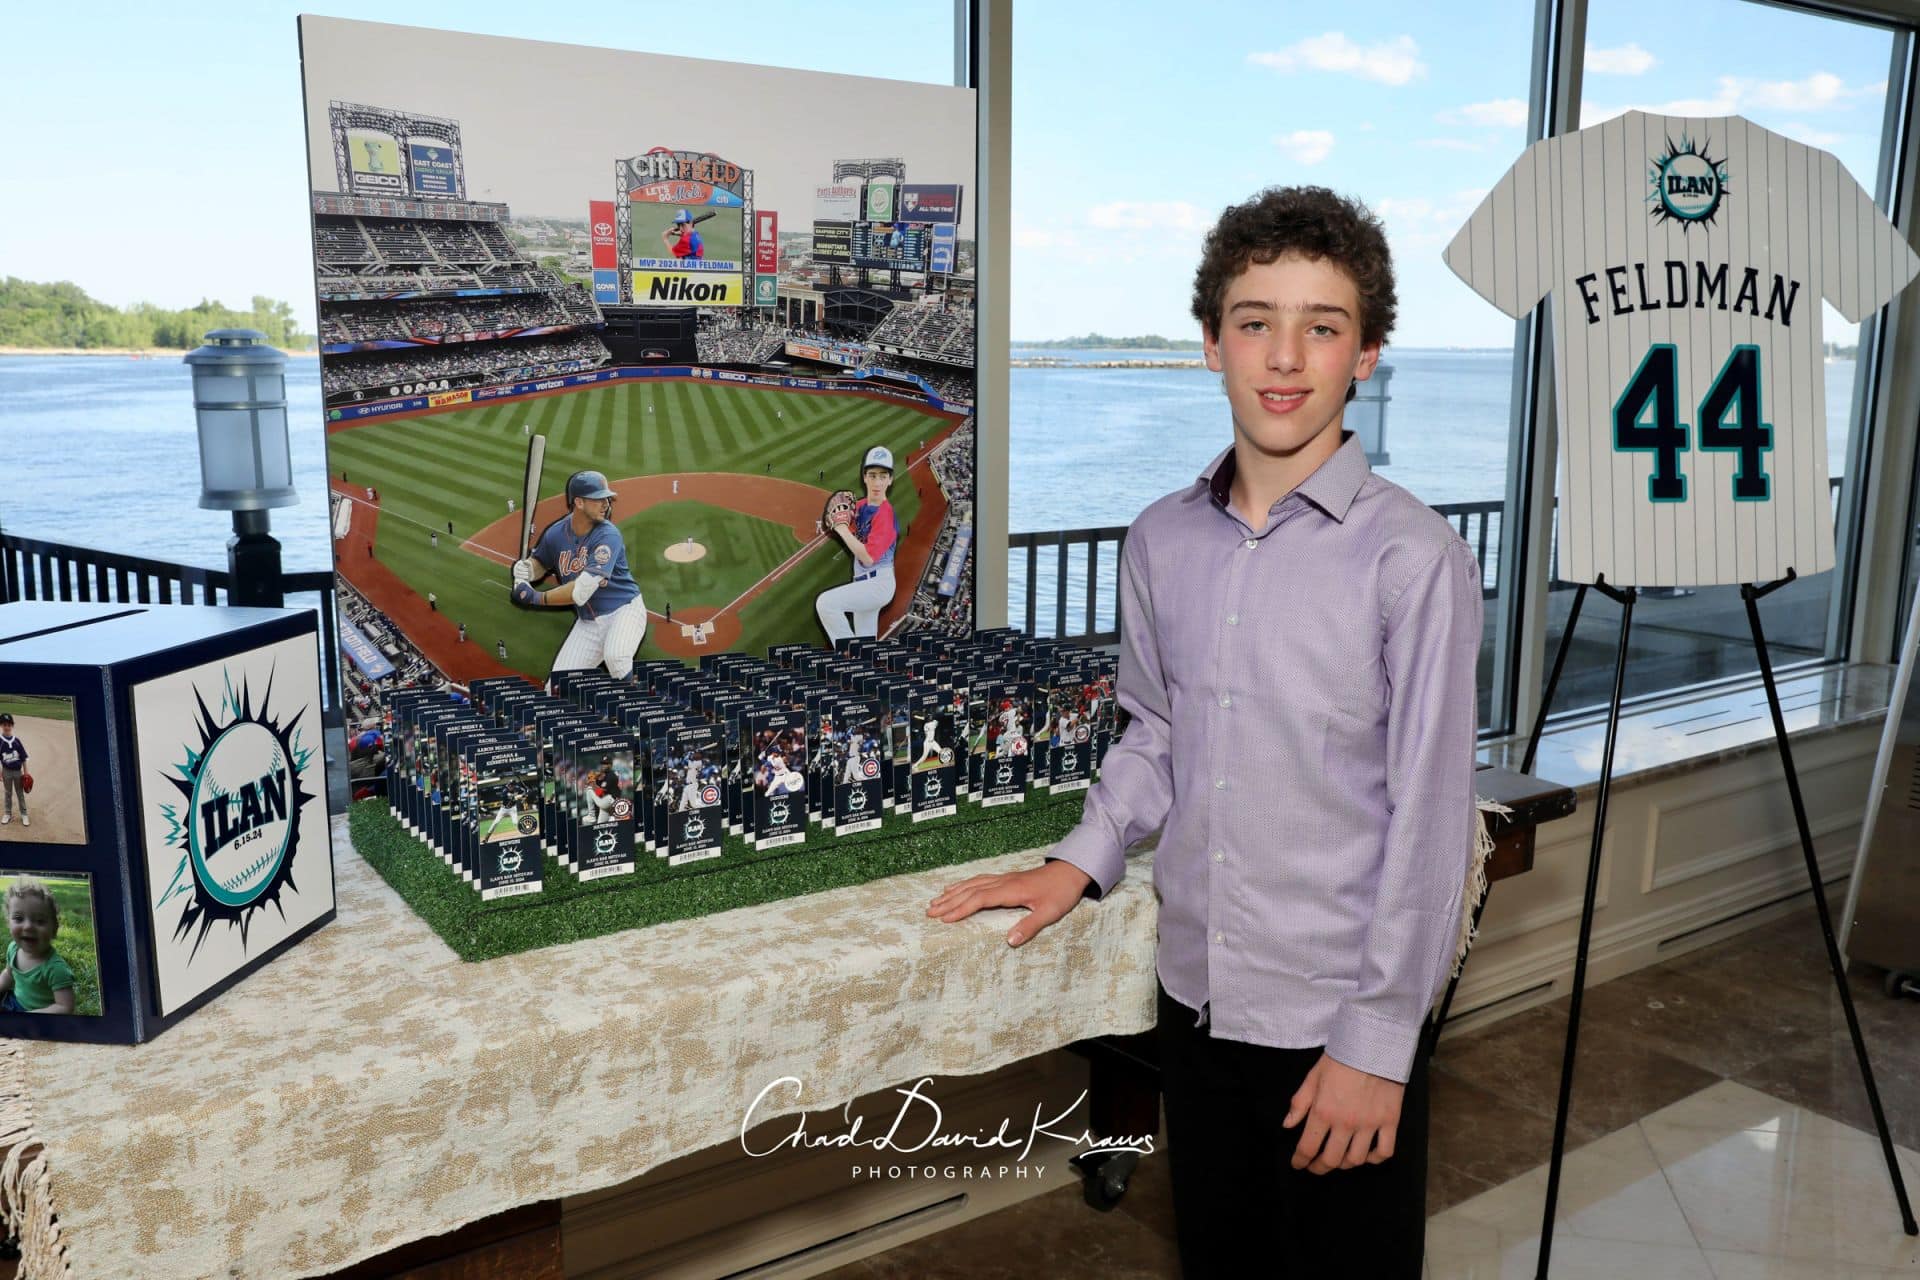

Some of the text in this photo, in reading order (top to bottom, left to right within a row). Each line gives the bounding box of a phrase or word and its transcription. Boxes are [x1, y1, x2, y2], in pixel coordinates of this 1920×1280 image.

[355, 174, 399, 186] GEICO
[679, 159, 740, 183] FIELD
[1667, 176, 1713, 196] ILAN
[640, 259, 734, 270] MVP 2024 ILAN FELDMAN
[649, 277, 727, 301] Nikon
[1576, 260, 1800, 326] FELDMAN
[920, 352, 939, 360] PRO
[535, 380, 564, 391] verizon
[719, 371, 746, 382] GEICO
[371, 402, 403, 412] HYUNDAI
[1612, 343, 1774, 503] 44
[201, 768, 287, 862] ILAN
[233, 828, 263, 851] 6.15.24
